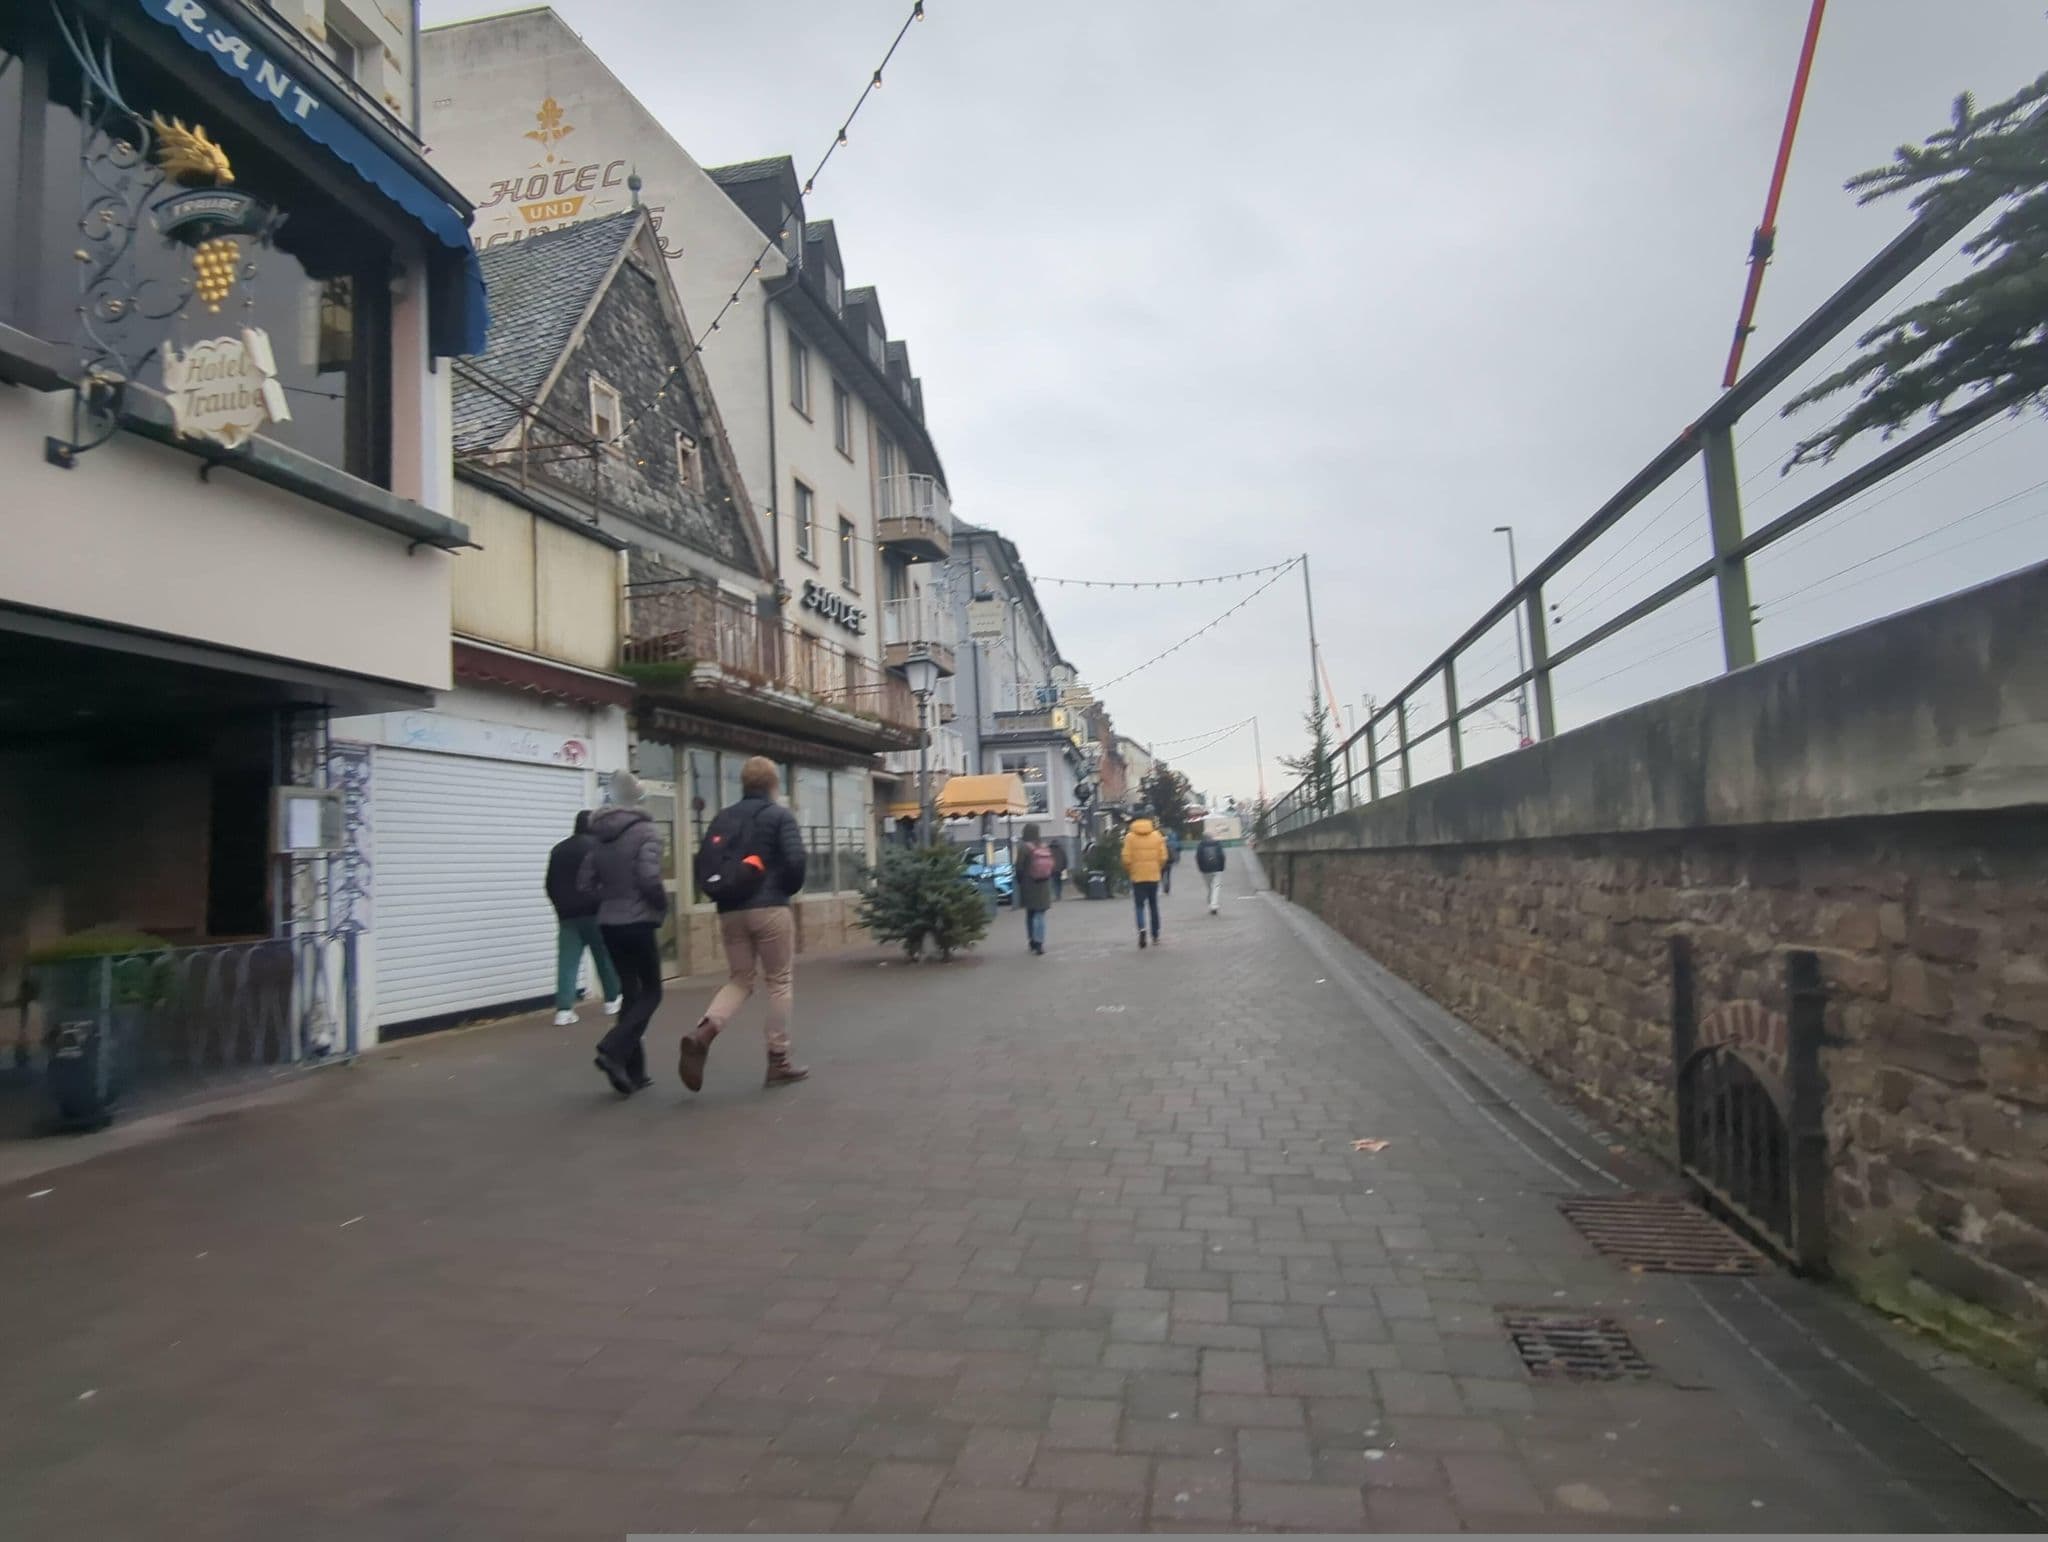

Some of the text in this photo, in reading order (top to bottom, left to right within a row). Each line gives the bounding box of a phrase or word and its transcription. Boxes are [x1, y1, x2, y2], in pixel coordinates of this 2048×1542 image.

[165, 0, 319, 119] RANT
[480, 160, 625, 208] HOTEL
[530, 201, 574, 220] UND
[186, 352, 248, 382] Hotel
[186, 383, 263, 417] Traube
